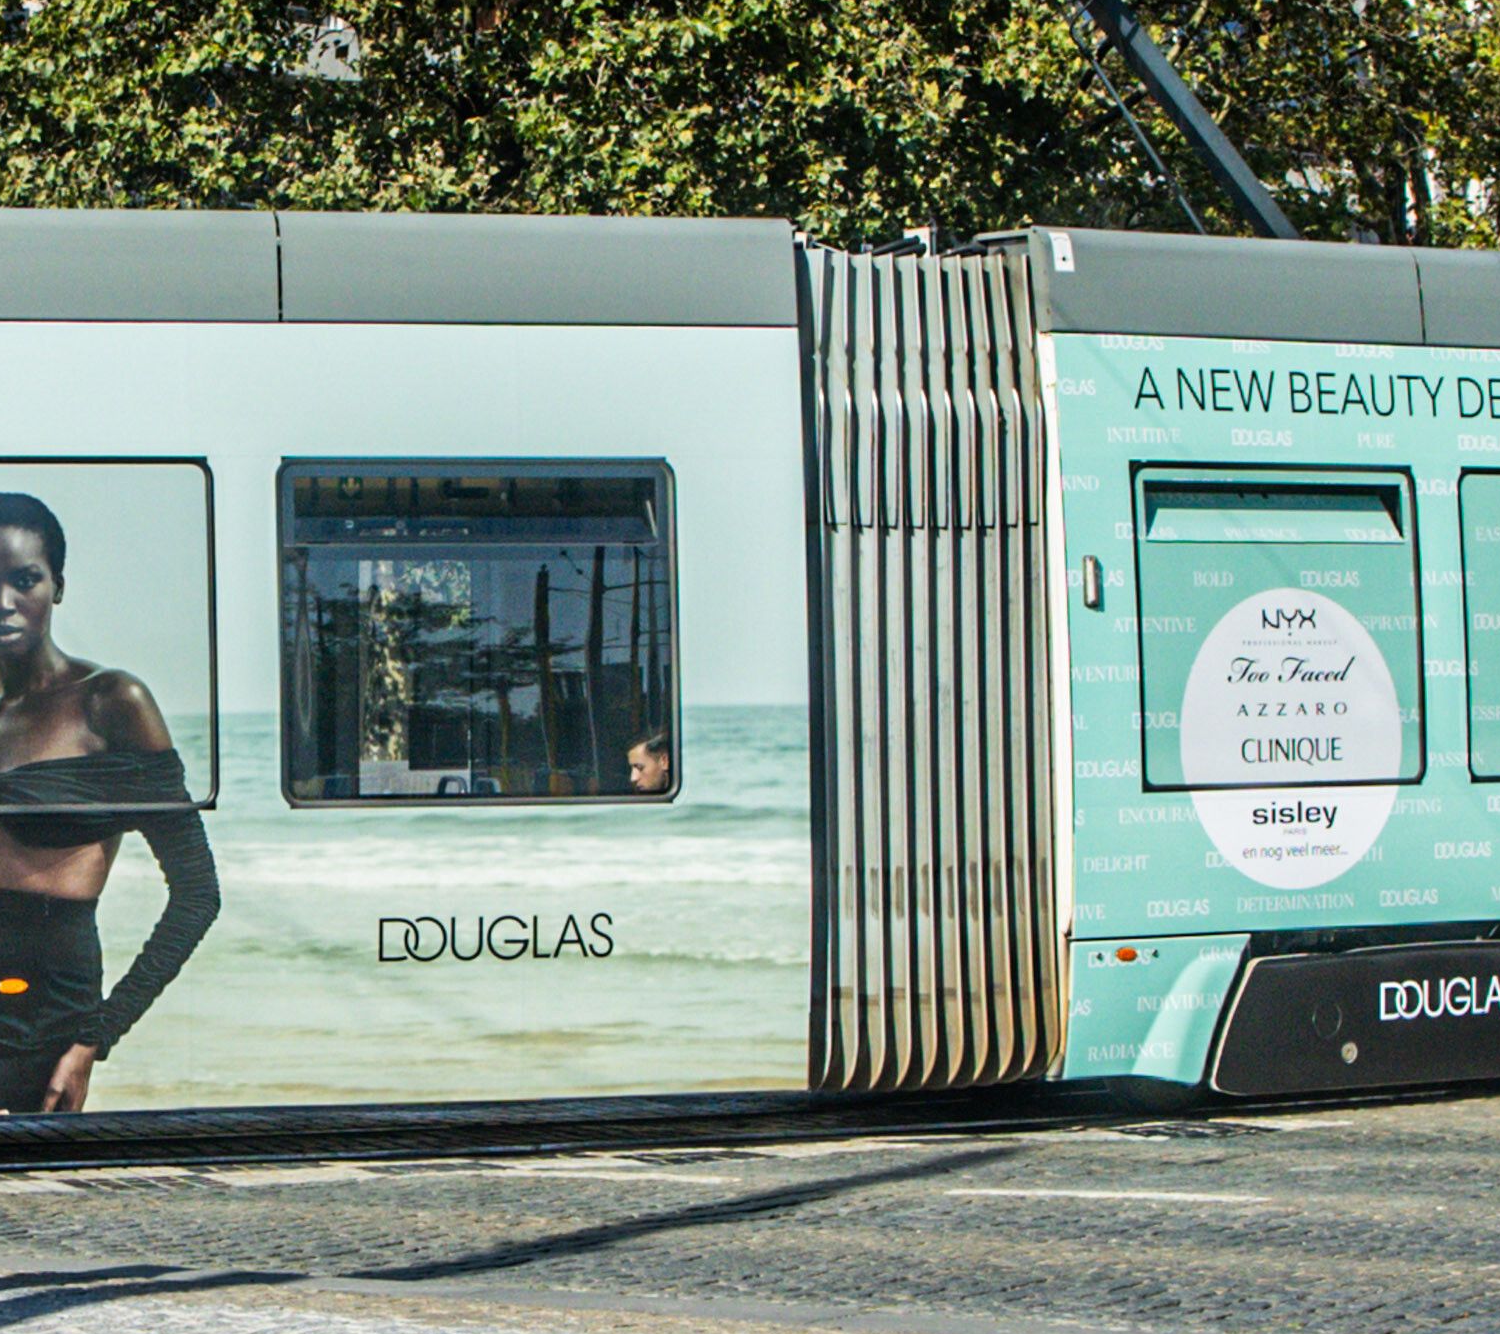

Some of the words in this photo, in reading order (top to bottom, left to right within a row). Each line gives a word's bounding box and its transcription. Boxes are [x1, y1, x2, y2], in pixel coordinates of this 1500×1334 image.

[1134, 366, 1165, 410] A
[1176, 367, 1275, 412] NEW
[1289, 371, 1444, 418] BEAUTY
[1106, 427, 1182, 444] INTUITIVE
[1231, 428, 1293, 447] DOUGLAS
[1358, 433, 1396, 450] PURE
[1193, 570, 1235, 587] BOLD
[1300, 570, 1360, 588] DOUGLAS
[1262, 608, 1316, 629] NYX
[1227, 657, 1270, 684] Too
[1277, 655, 1356, 684] Faced
[1237, 701, 1348, 717] AZZARO
[1241, 736, 1344, 766] CLINIQUE
[1075, 760, 1139, 778] DOUGLAS
[1252, 800, 1338, 829] sisley
[1242, 846, 1257, 858] en
[1260, 845, 1283, 861] nog
[1286, 842, 1309, 858] veel
[1434, 841, 1493, 859] DOUGLAS
[1083, 854, 1150, 873] DELIGHT
[1236, 893, 1356, 913] DETERMINATION
[1379, 888, 1439, 907] DOUGLAS
[1146, 898, 1210, 918] DOUGLAS
[378, 911, 614, 962] DOUGLAS
[1088, 1042, 1175, 1062] RADIANCE
